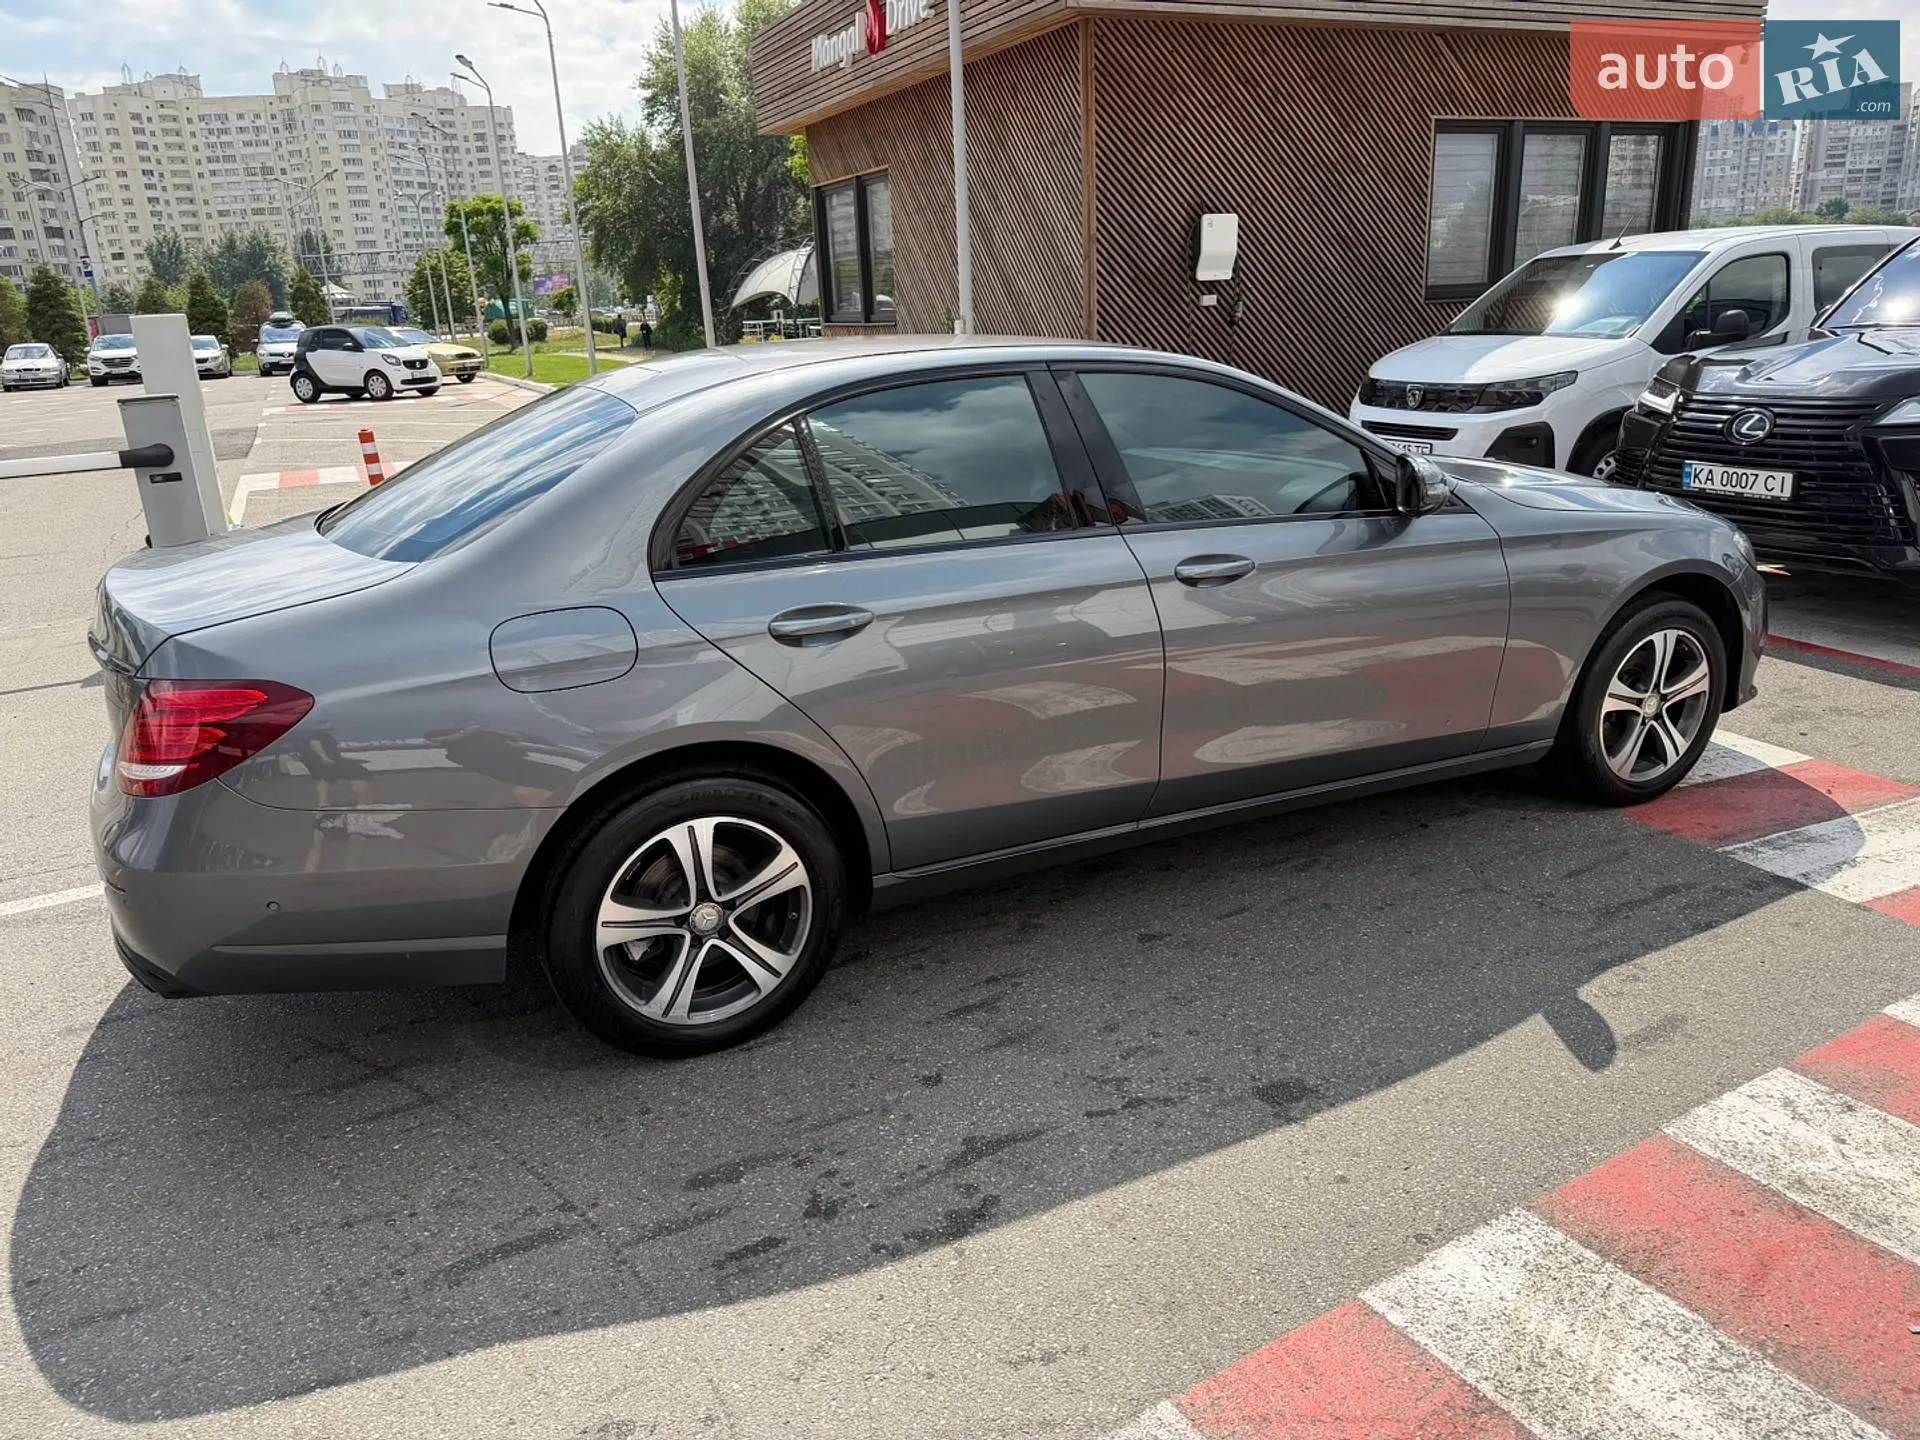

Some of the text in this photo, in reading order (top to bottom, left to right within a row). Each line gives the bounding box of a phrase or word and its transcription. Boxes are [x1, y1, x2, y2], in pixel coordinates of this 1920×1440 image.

[811, 0, 935, 71] Mangal Drive
[1693, 466, 1785, 493] KA 0007 CI
